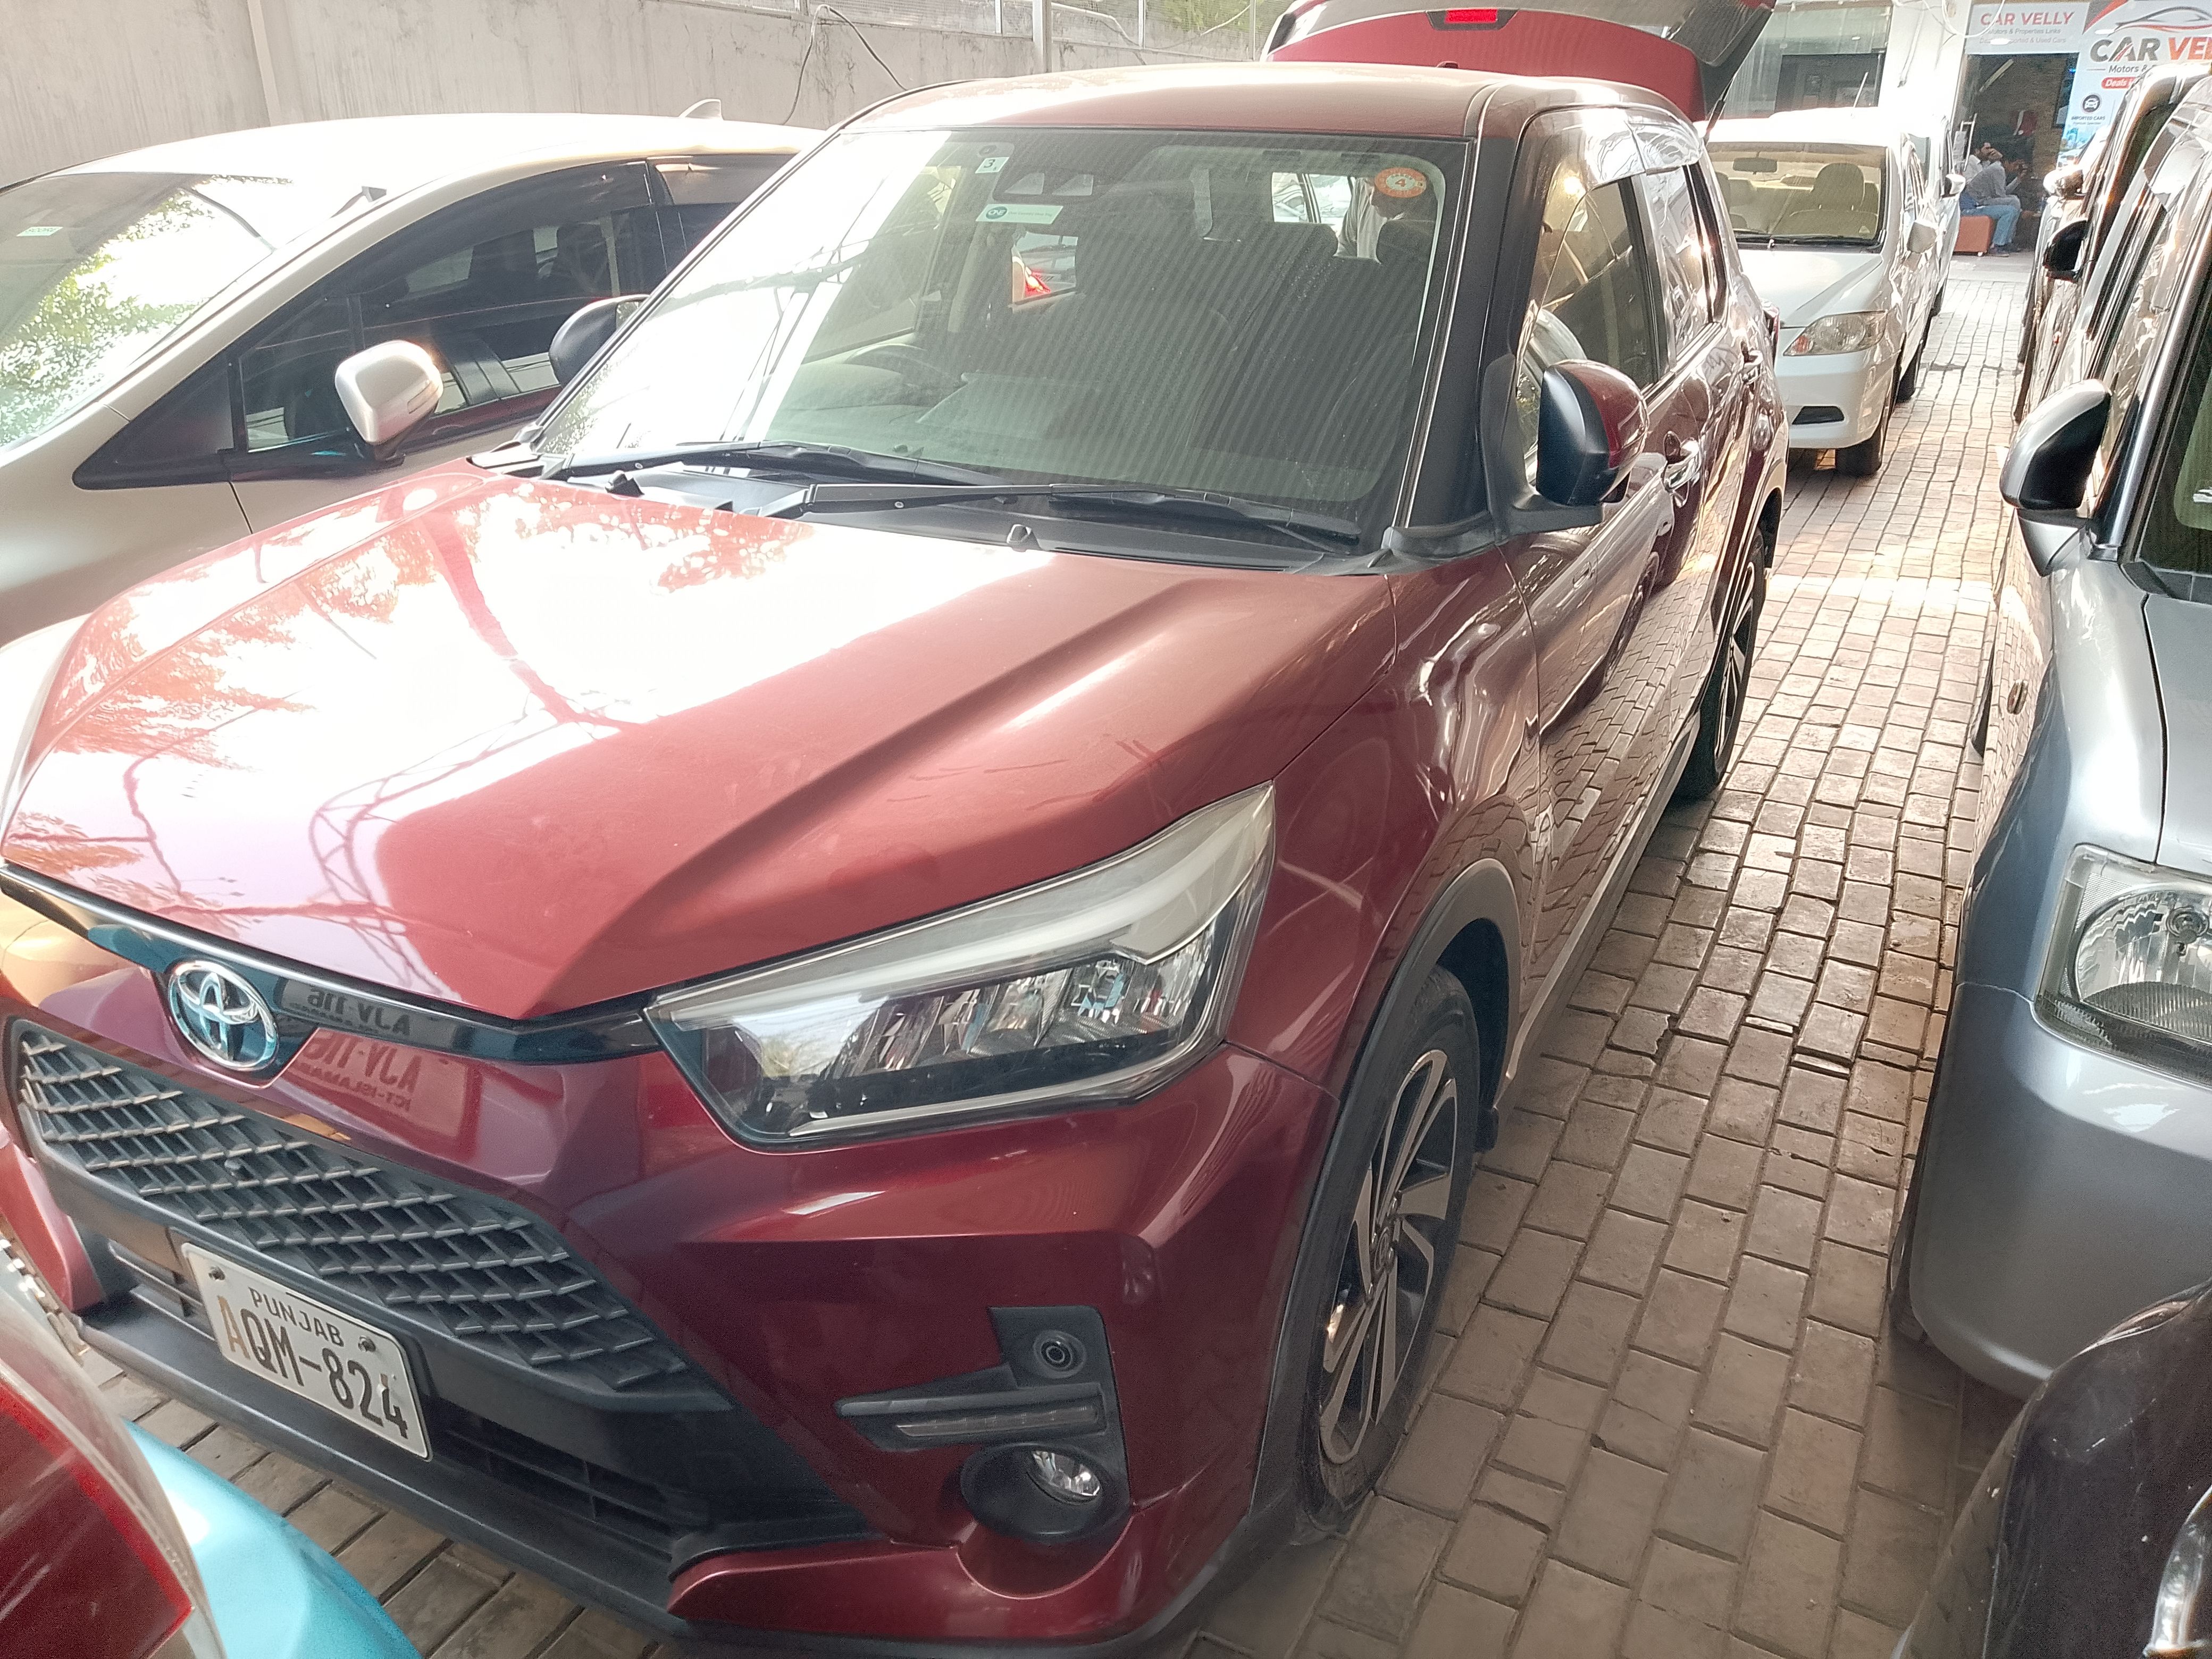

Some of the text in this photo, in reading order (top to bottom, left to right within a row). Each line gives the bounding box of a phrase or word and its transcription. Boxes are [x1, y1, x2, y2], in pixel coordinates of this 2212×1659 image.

[1980, 12, 2075, 26] CAR VELLY
[2090, 37, 2161, 62] CAR
[2108, 64, 2139, 73] Motors
[984, 159, 996, 168] 3
[1395, 178, 1406, 187] 4
[248, 1287, 345, 1347] PUNJAB
[217, 1295, 408, 1440] AQM-824
